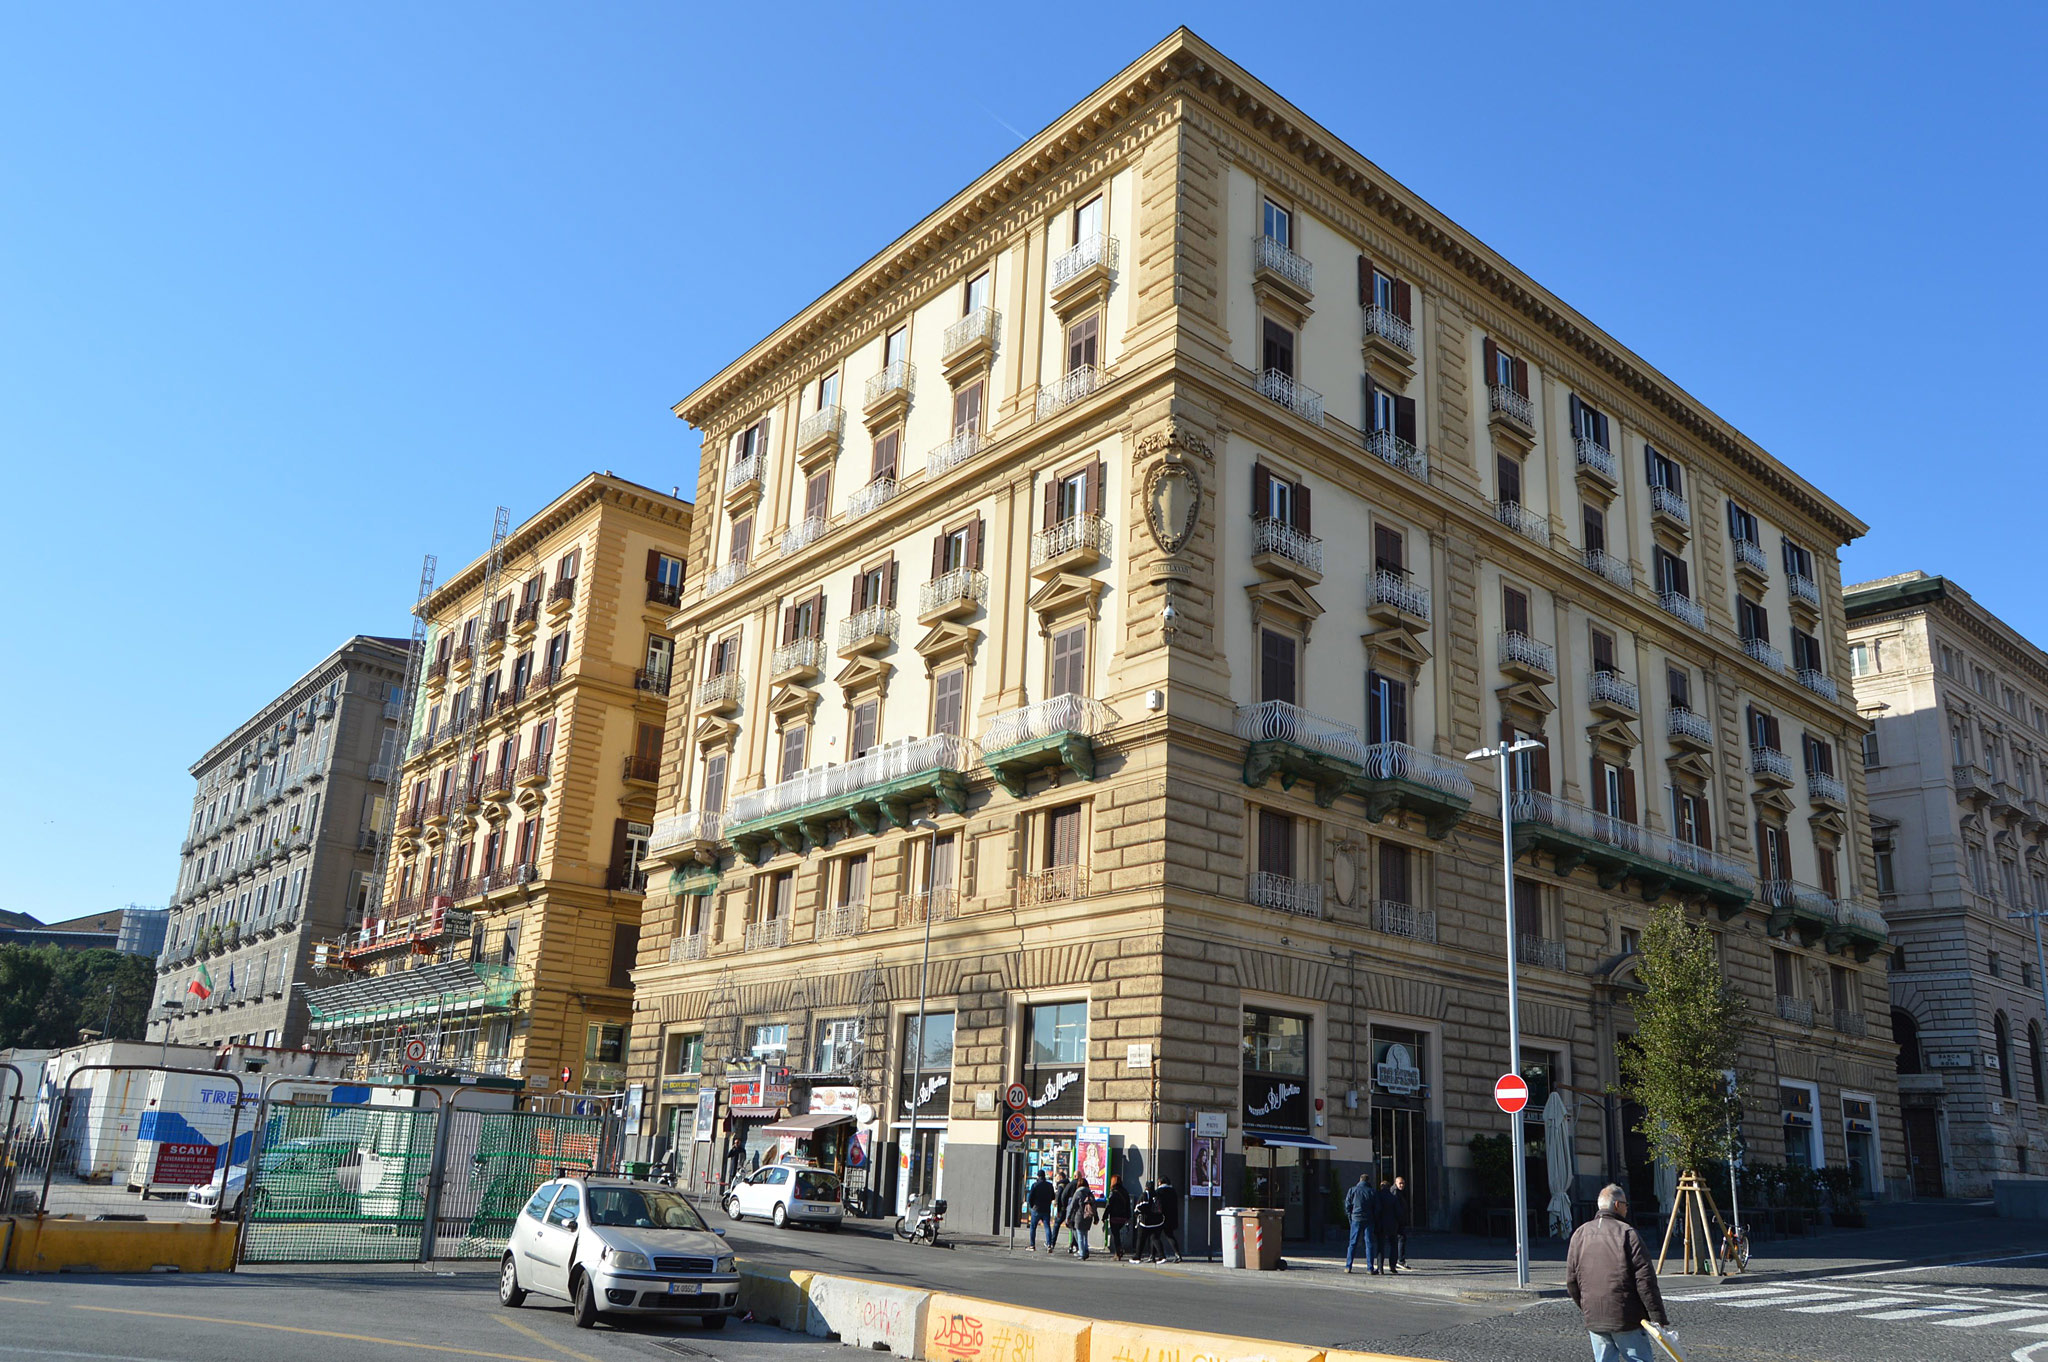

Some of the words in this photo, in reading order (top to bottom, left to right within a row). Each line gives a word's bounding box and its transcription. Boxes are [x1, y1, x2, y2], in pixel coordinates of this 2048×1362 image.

[765, 1084, 787, 1093] BAR
[1011, 1090, 1024, 1103] 20
[170, 1145, 208, 1156] SCAVI
